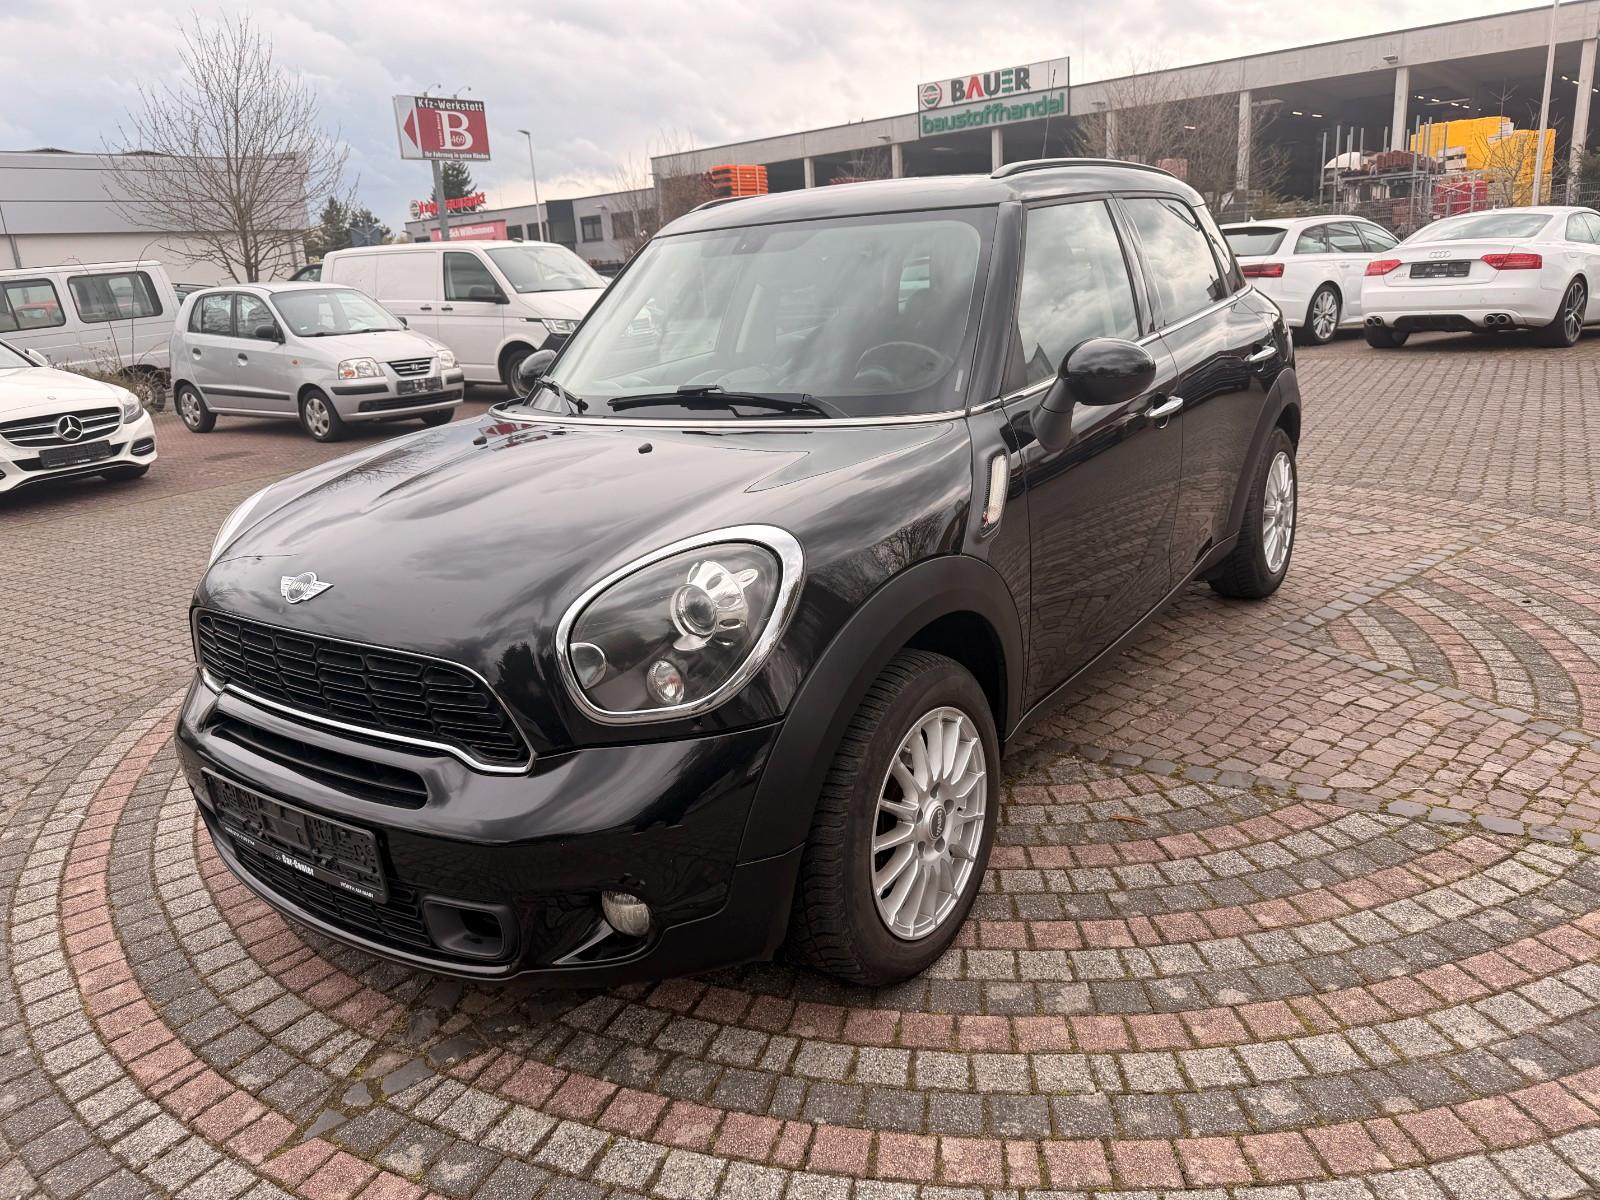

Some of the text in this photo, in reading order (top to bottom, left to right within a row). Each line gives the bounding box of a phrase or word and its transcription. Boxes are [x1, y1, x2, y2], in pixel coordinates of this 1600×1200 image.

[951, 67, 1031, 103] BAUER
[418, 98, 484, 112] Kfz-Werkstatt
[922, 92, 1065, 134] baustoffhandel
[435, 110, 473, 150] B
